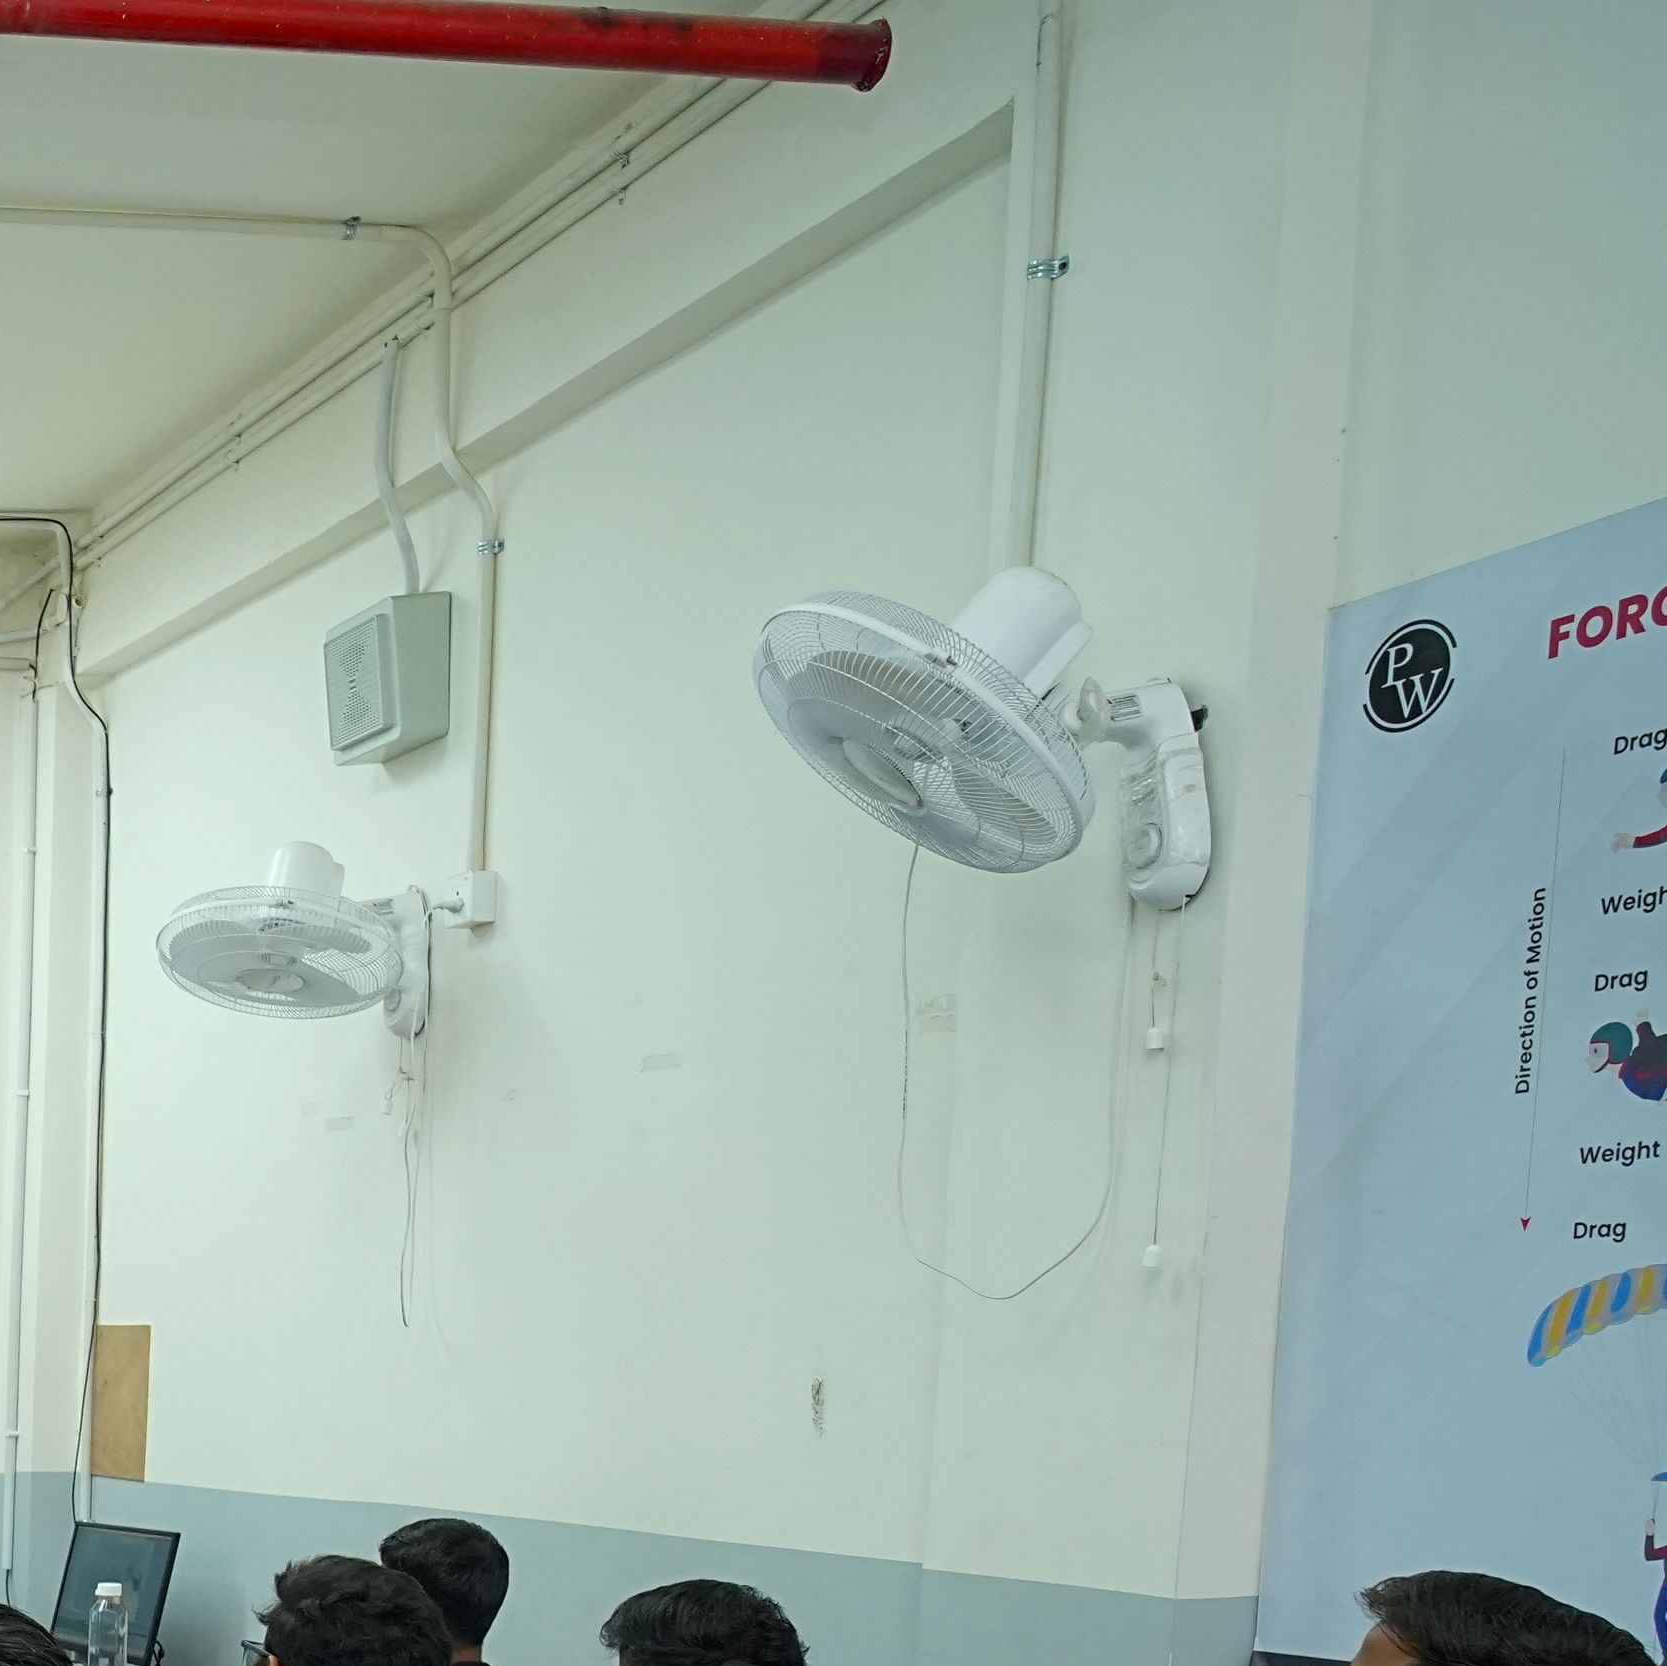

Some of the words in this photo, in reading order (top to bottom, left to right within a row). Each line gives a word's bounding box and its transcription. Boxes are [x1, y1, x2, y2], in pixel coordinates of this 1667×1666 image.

[1380, 642, 1444, 719] PW
[1613, 727, 1667, 756] Drag
[1600, 885, 1667, 915] Weigh
[1526, 887, 1547, 963] Motion
[1524, 971, 1540, 990] of
[1593, 969, 1649, 993] Drag
[1515, 994, 1537, 1095] Direction
[1578, 1139, 1661, 1166] Weight
[1571, 1219, 1628, 1243] Drag
